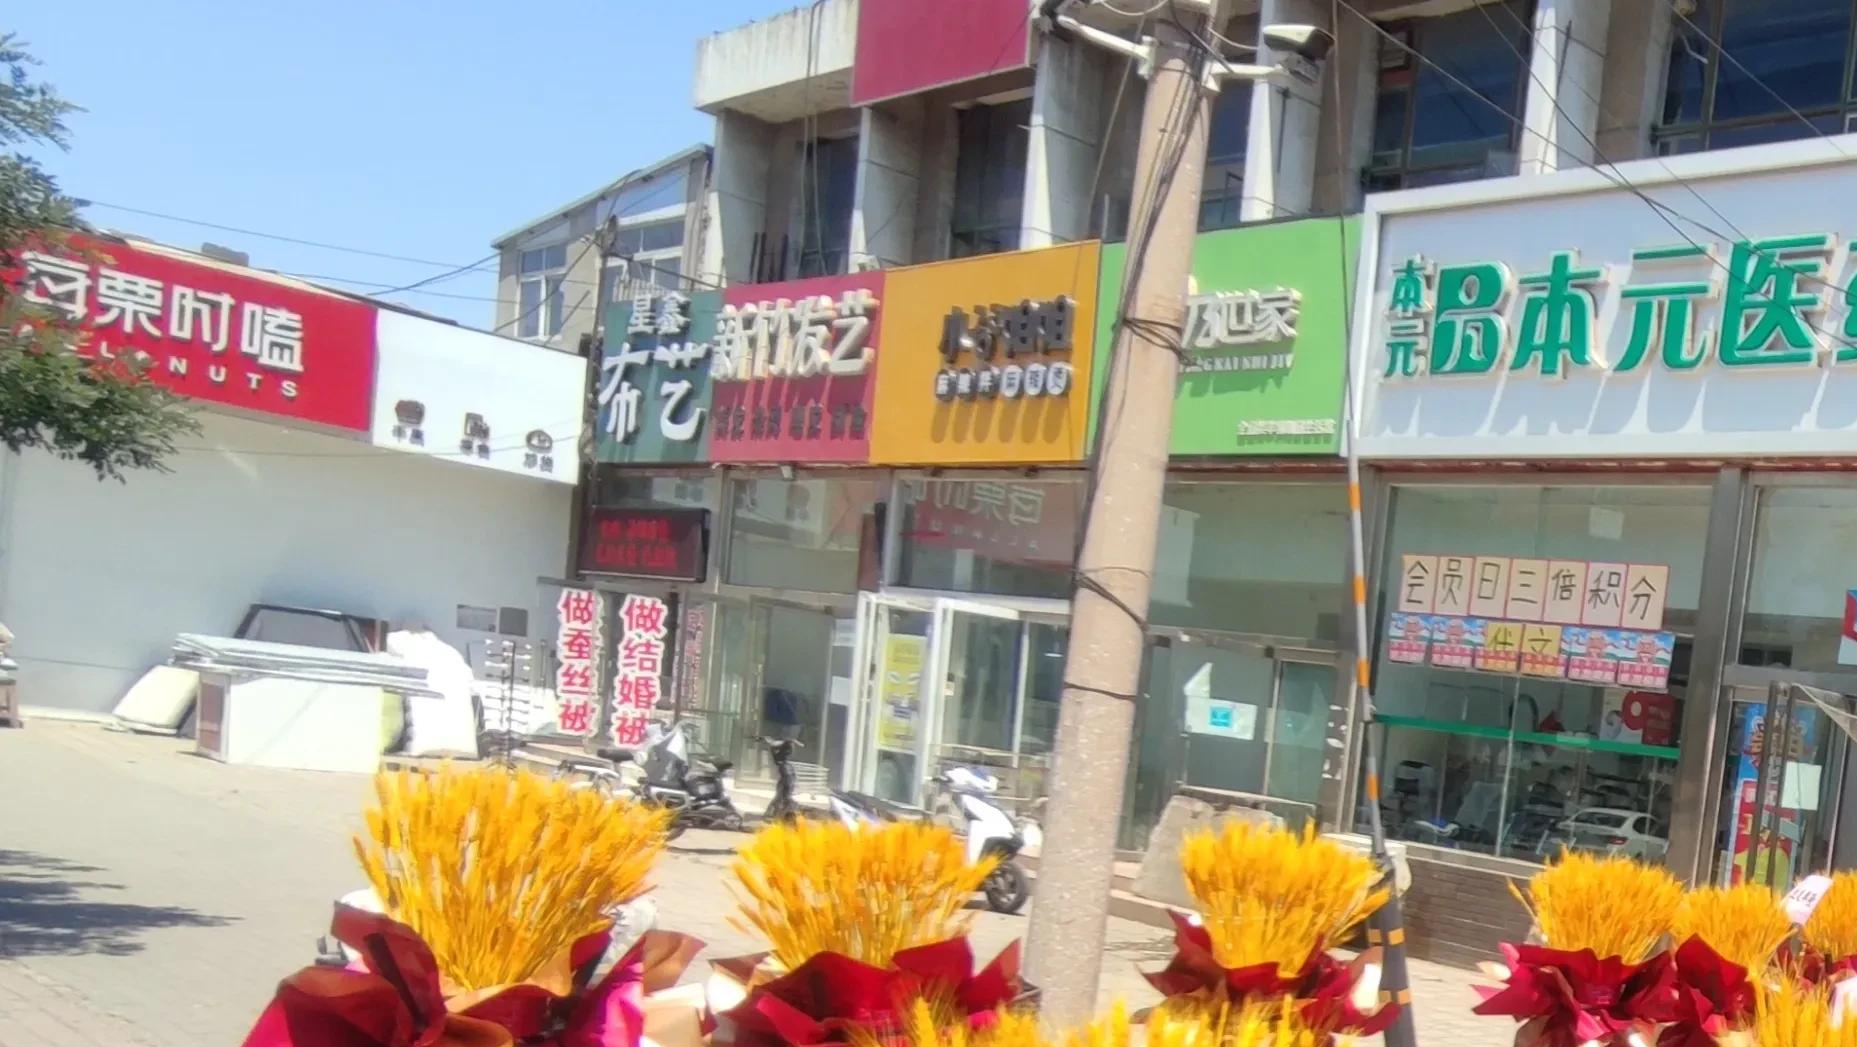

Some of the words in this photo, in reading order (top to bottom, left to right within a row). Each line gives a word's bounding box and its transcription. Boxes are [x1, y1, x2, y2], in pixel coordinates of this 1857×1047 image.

[598, 342, 711, 443] 布艺
[1405, 558, 1657, 621] 会员日三倍积分
[559, 590, 597, 735] 做蚕丝被
[614, 596, 666, 747] 做结婚被
